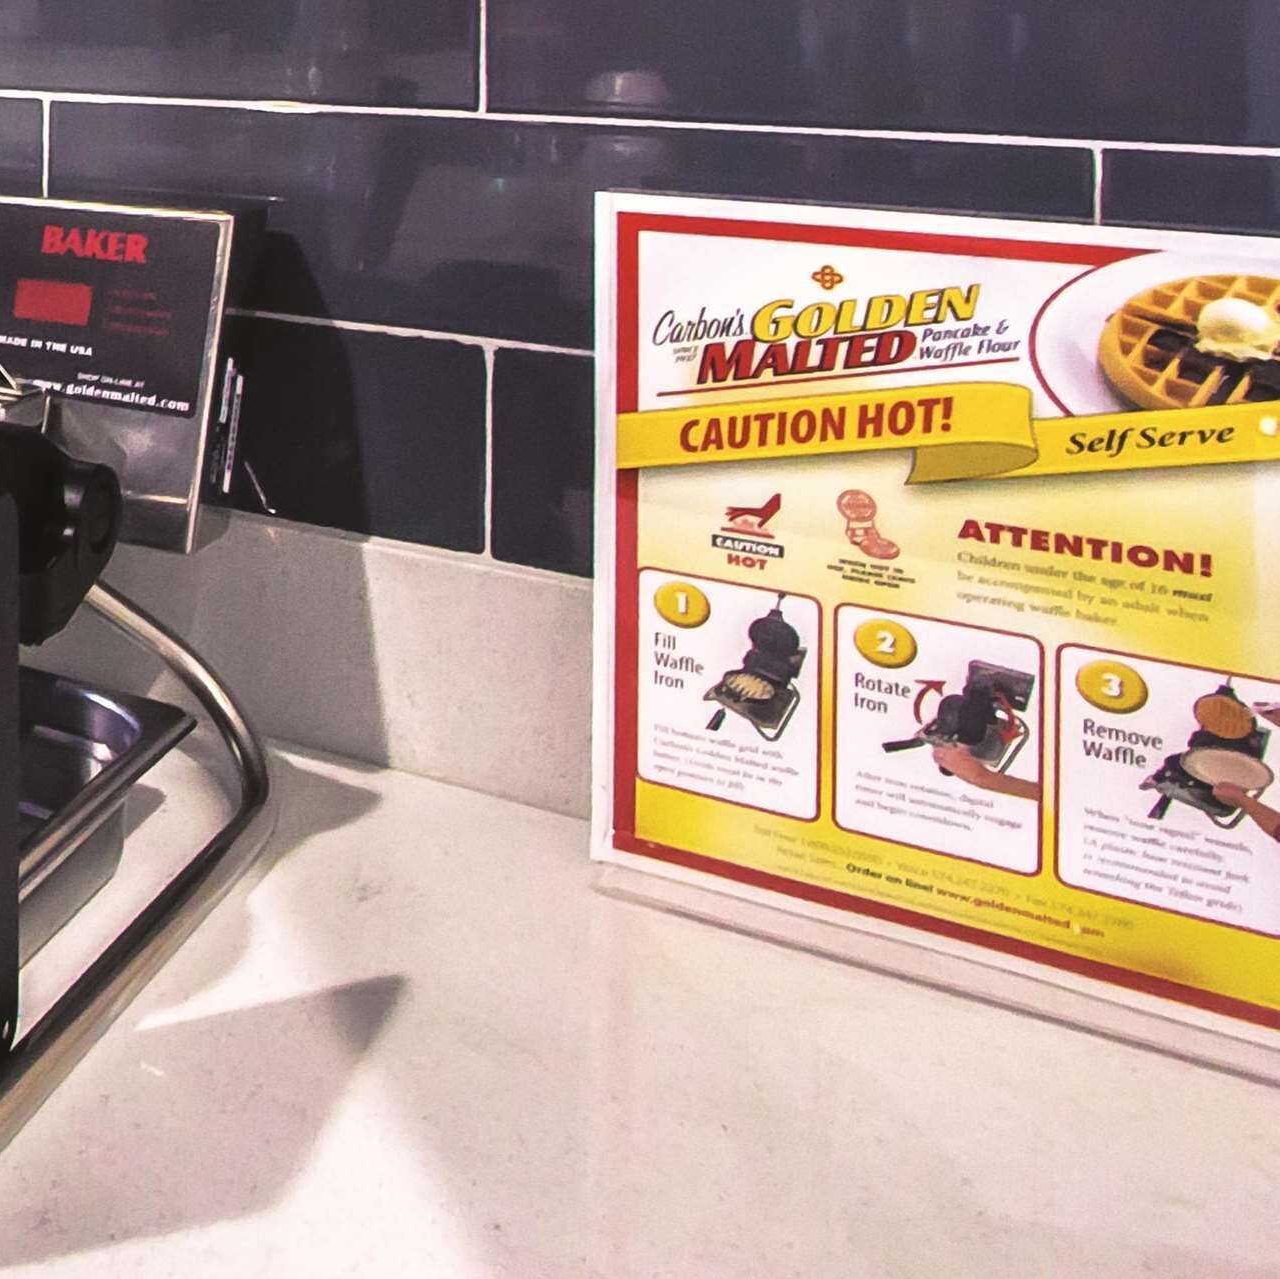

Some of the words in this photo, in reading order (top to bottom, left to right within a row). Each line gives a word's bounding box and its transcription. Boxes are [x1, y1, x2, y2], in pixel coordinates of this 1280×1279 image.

[41, 224, 149, 265] BAKER
[652, 306, 745, 347] Carbon's
[749, 283, 981, 344] GOLDEN
[921, 323, 992, 343] Pancake
[996, 319, 1010, 336] &
[30, 339, 43, 350] IN
[45, 341, 67, 353] THE
[69, 344, 93, 357] USA
[696, 329, 917, 386] MALTED
[918, 341, 973, 362] Waffle
[978, 337, 1021, 355] Flour
[679, 406, 847, 453] CAUTION
[856, 396, 955, 439] HOT!
[1065, 426, 1135, 458] Self
[1135, 426, 1235, 450] Serve
[715, 536, 781, 557] CAUTION
[957, 519, 1213, 578] ATTENTION!
[727, 553, 768, 570] HOT
[674, 591, 689, 616] 1
[654, 630, 677, 652] Fill
[875, 630, 896, 656] 2
[654, 651, 706, 676] Waffle
[653, 670, 685, 690] Iron
[854, 671, 912, 699] Rotate
[1100, 672, 1123, 699] 3
[854, 692, 889, 715] Iron
[1082, 718, 1164, 752] Remove
[1082, 738, 1147, 770] Waffle
[845, 861, 884, 882] Order
[885, 872, 903, 887] on
